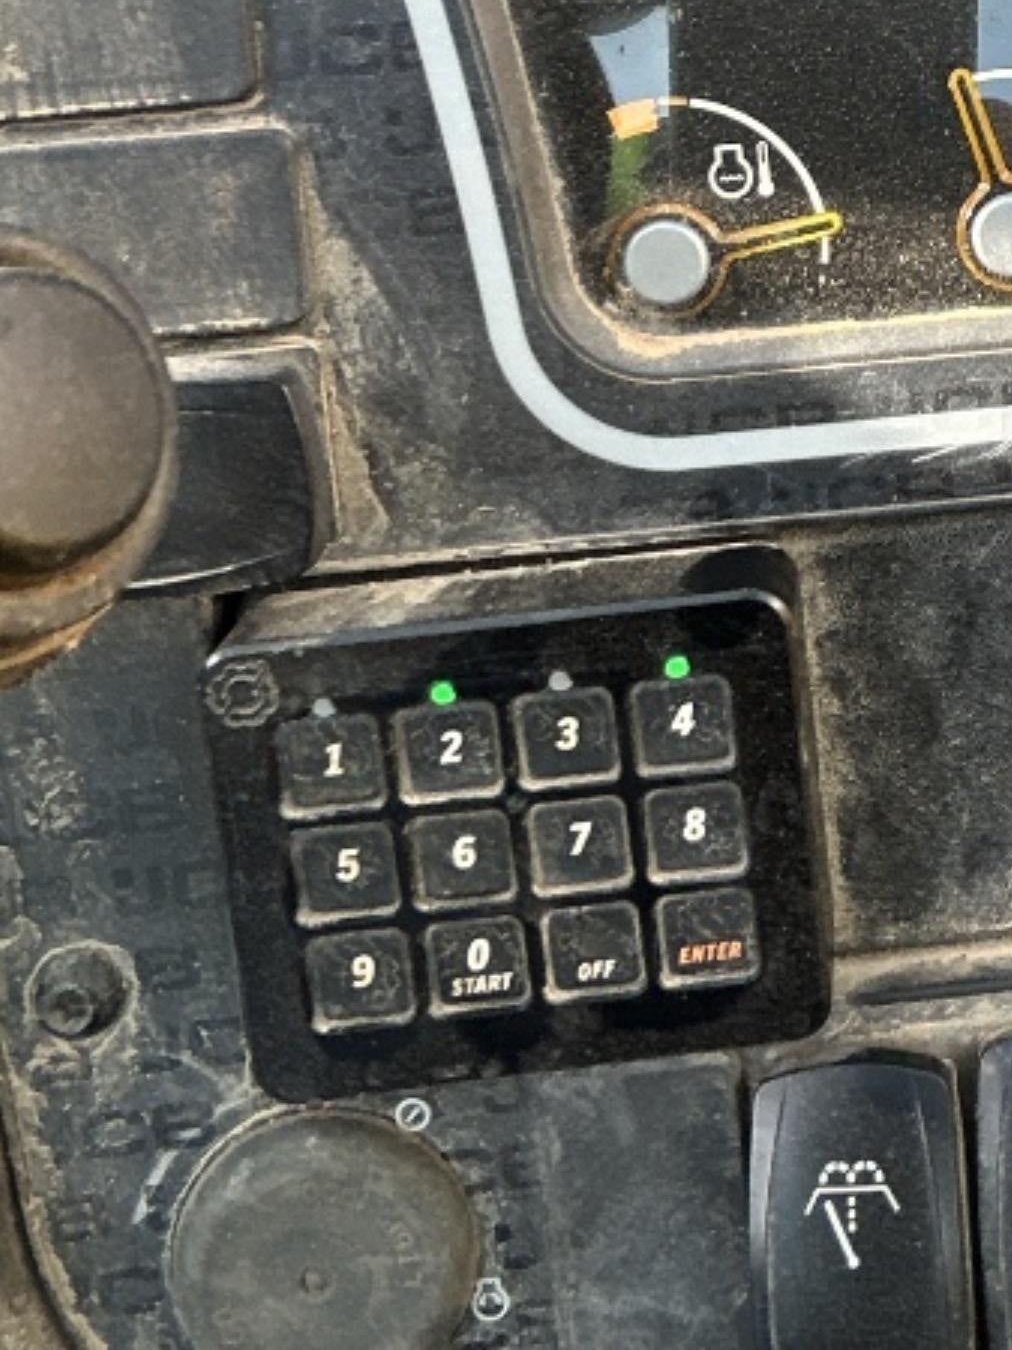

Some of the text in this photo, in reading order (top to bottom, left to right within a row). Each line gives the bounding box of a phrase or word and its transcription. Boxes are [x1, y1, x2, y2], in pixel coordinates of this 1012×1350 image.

[556, 716, 580, 751] 3
[670, 702, 695, 737] 4
[324, 742, 345, 777] 1
[440, 730, 463, 765] 2
[568, 821, 592, 856] 7
[682, 808, 707, 843] 8
[336, 848, 360, 882] 5
[452, 835, 477, 869] 6
[466, 938, 490, 972] 0
[678, 940, 742, 965] ENTER
[352, 955, 376, 988] 9
[451, 971, 514, 997] START
[577, 959, 616, 982] OFF
